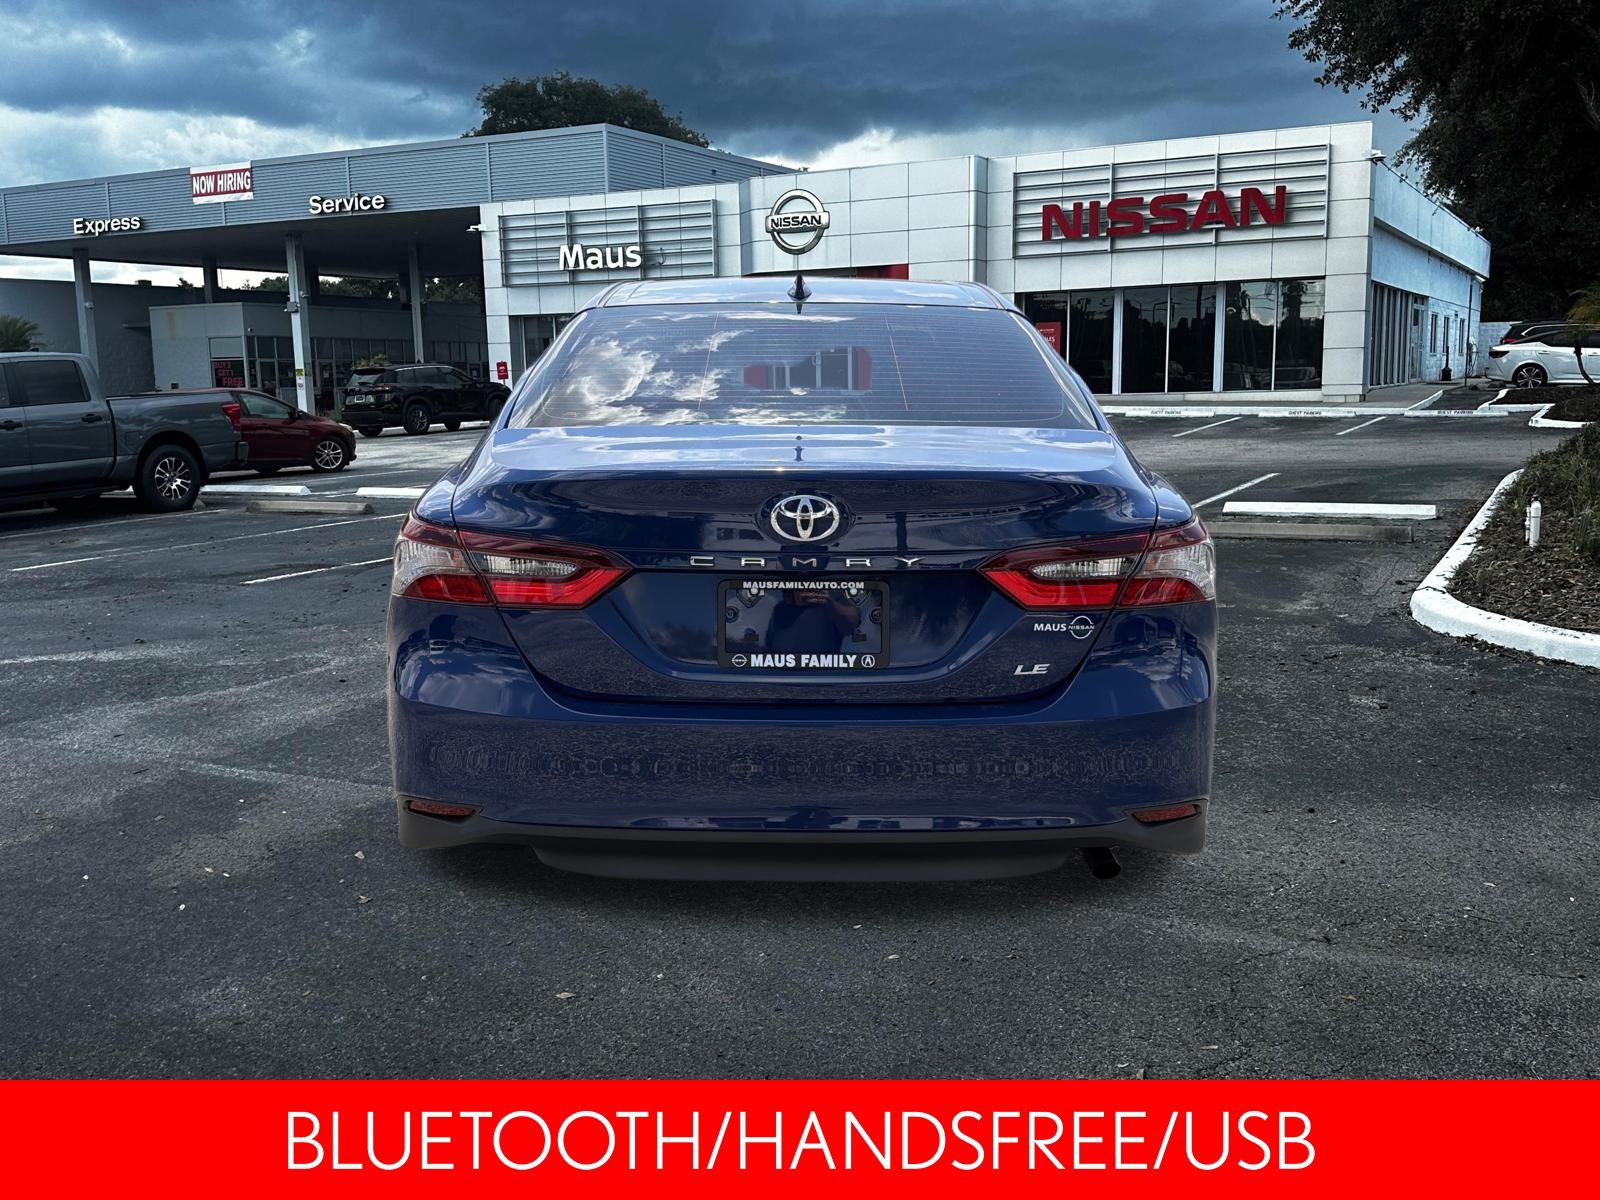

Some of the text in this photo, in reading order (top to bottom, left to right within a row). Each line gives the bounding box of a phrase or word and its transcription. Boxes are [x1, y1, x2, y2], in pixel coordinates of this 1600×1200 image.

[192, 170, 251, 195] NOW HIRING
[309, 193, 386, 215] Service
[1041, 185, 1287, 242] NISSAN
[73, 216, 142, 237] Express
[770, 214, 822, 229] NISSAN
[559, 242, 642, 271] Maus
[690, 556, 925, 568] CAMRY
[742, 581, 865, 589] MAUSFAMILYAUTO.COM
[1033, 623, 1067, 632] MAUS
[750, 653, 857, 668] MAUS FAMILY
[1013, 663, 1051, 676] LE
